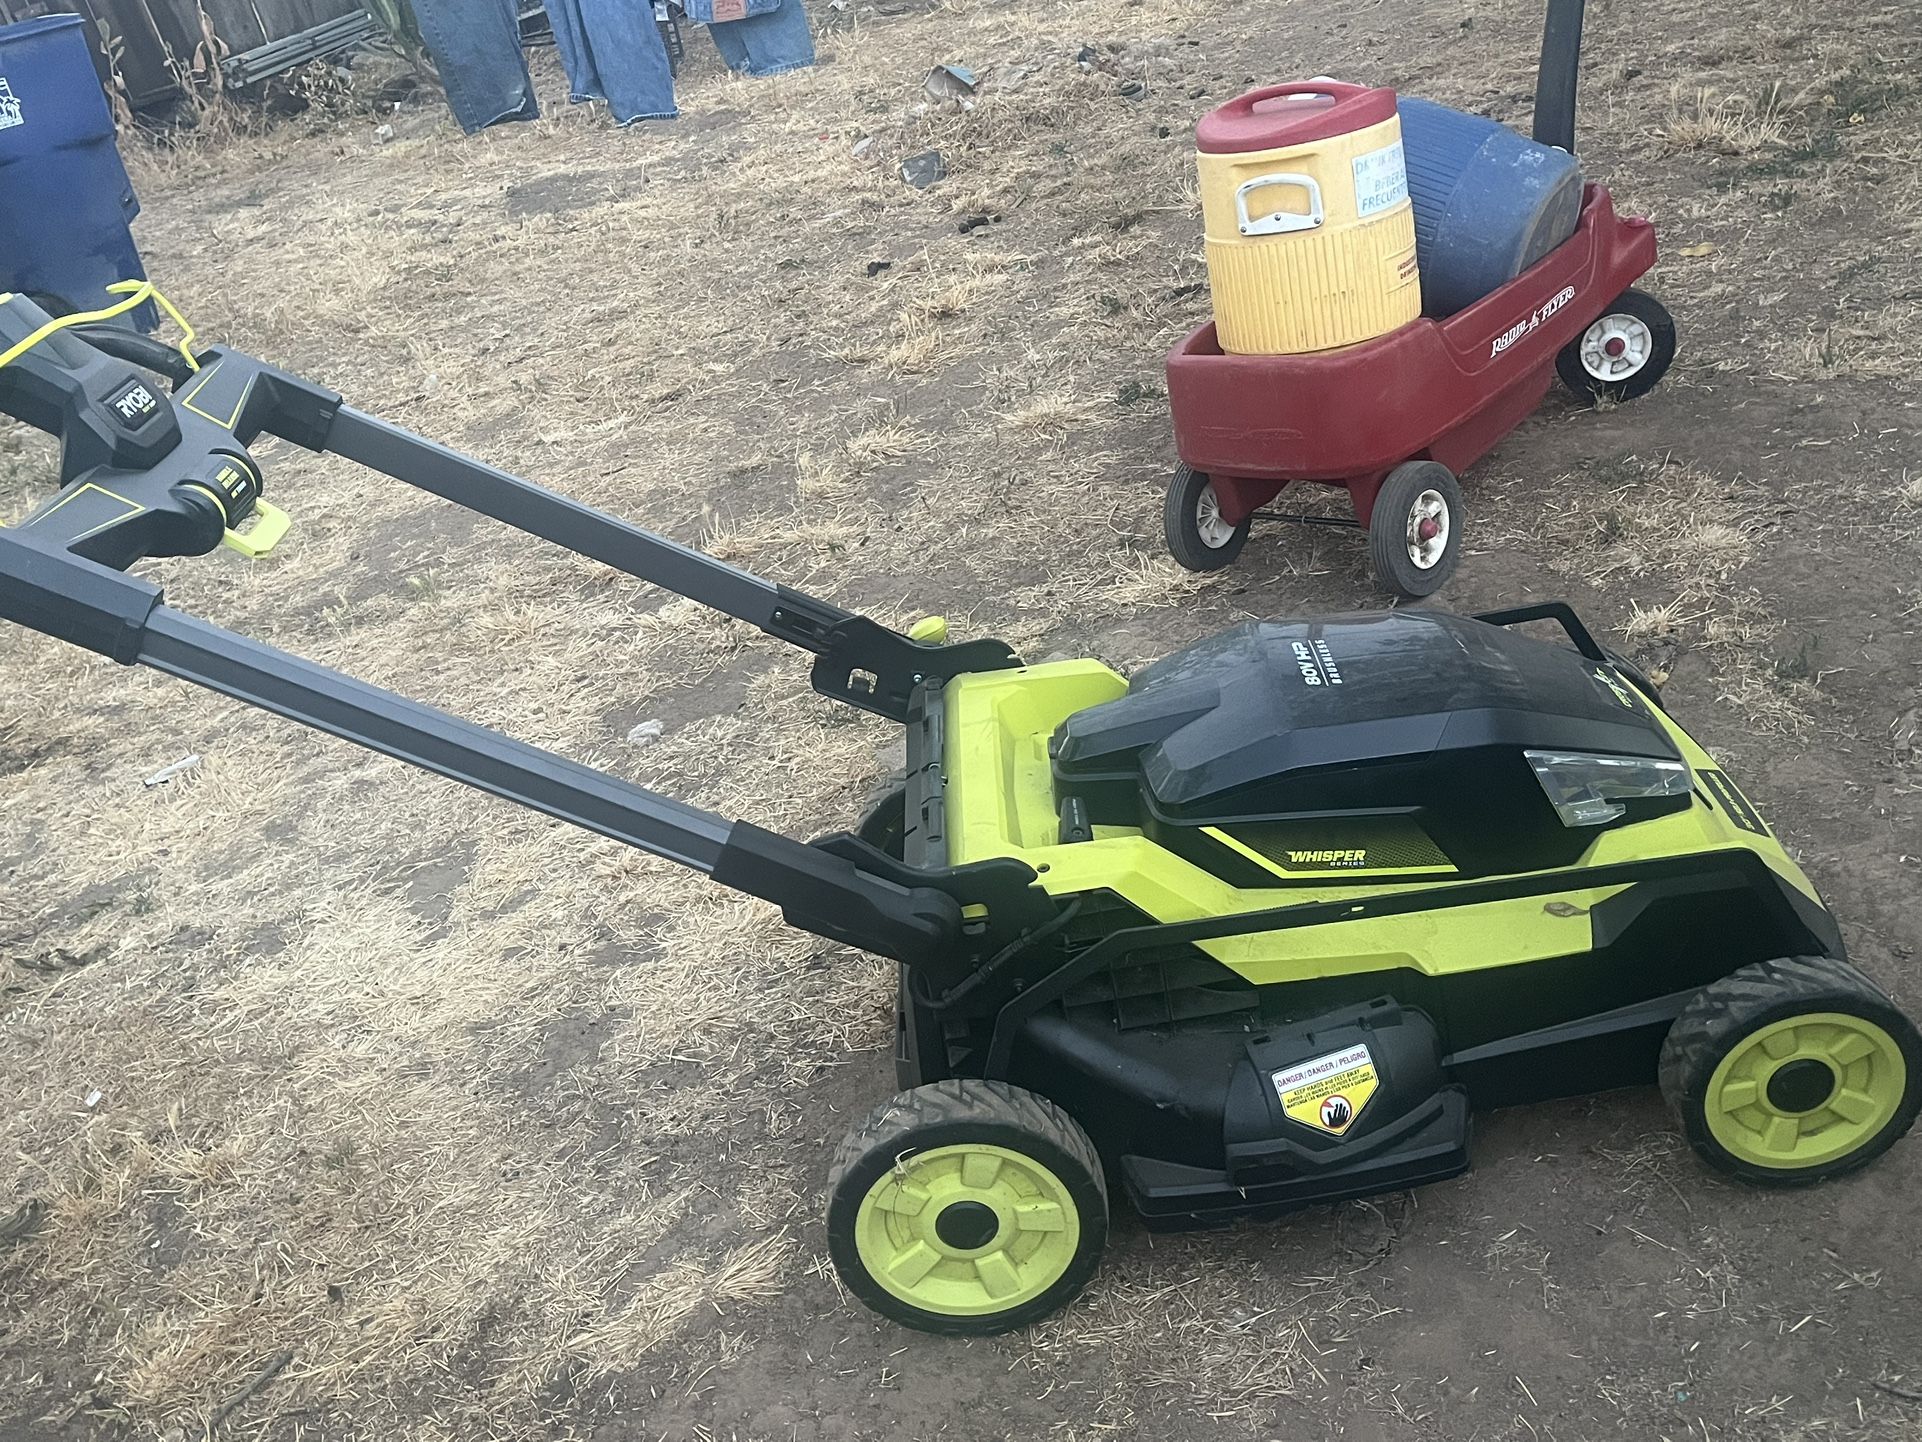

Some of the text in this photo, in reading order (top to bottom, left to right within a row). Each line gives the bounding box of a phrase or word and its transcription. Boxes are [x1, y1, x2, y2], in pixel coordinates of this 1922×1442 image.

[1490, 286, 1576, 358] RADIO FLYER
[115, 385, 153, 418] RYOBI
[1314, 639, 1343, 684] BRUSHLESS
[1286, 850, 1366, 862] WHISPER
[1278, 1072, 1305, 1087] DANGER
[1308, 1061, 1335, 1077] DANGER
[1339, 1051, 1366, 1066] PELIGRO
